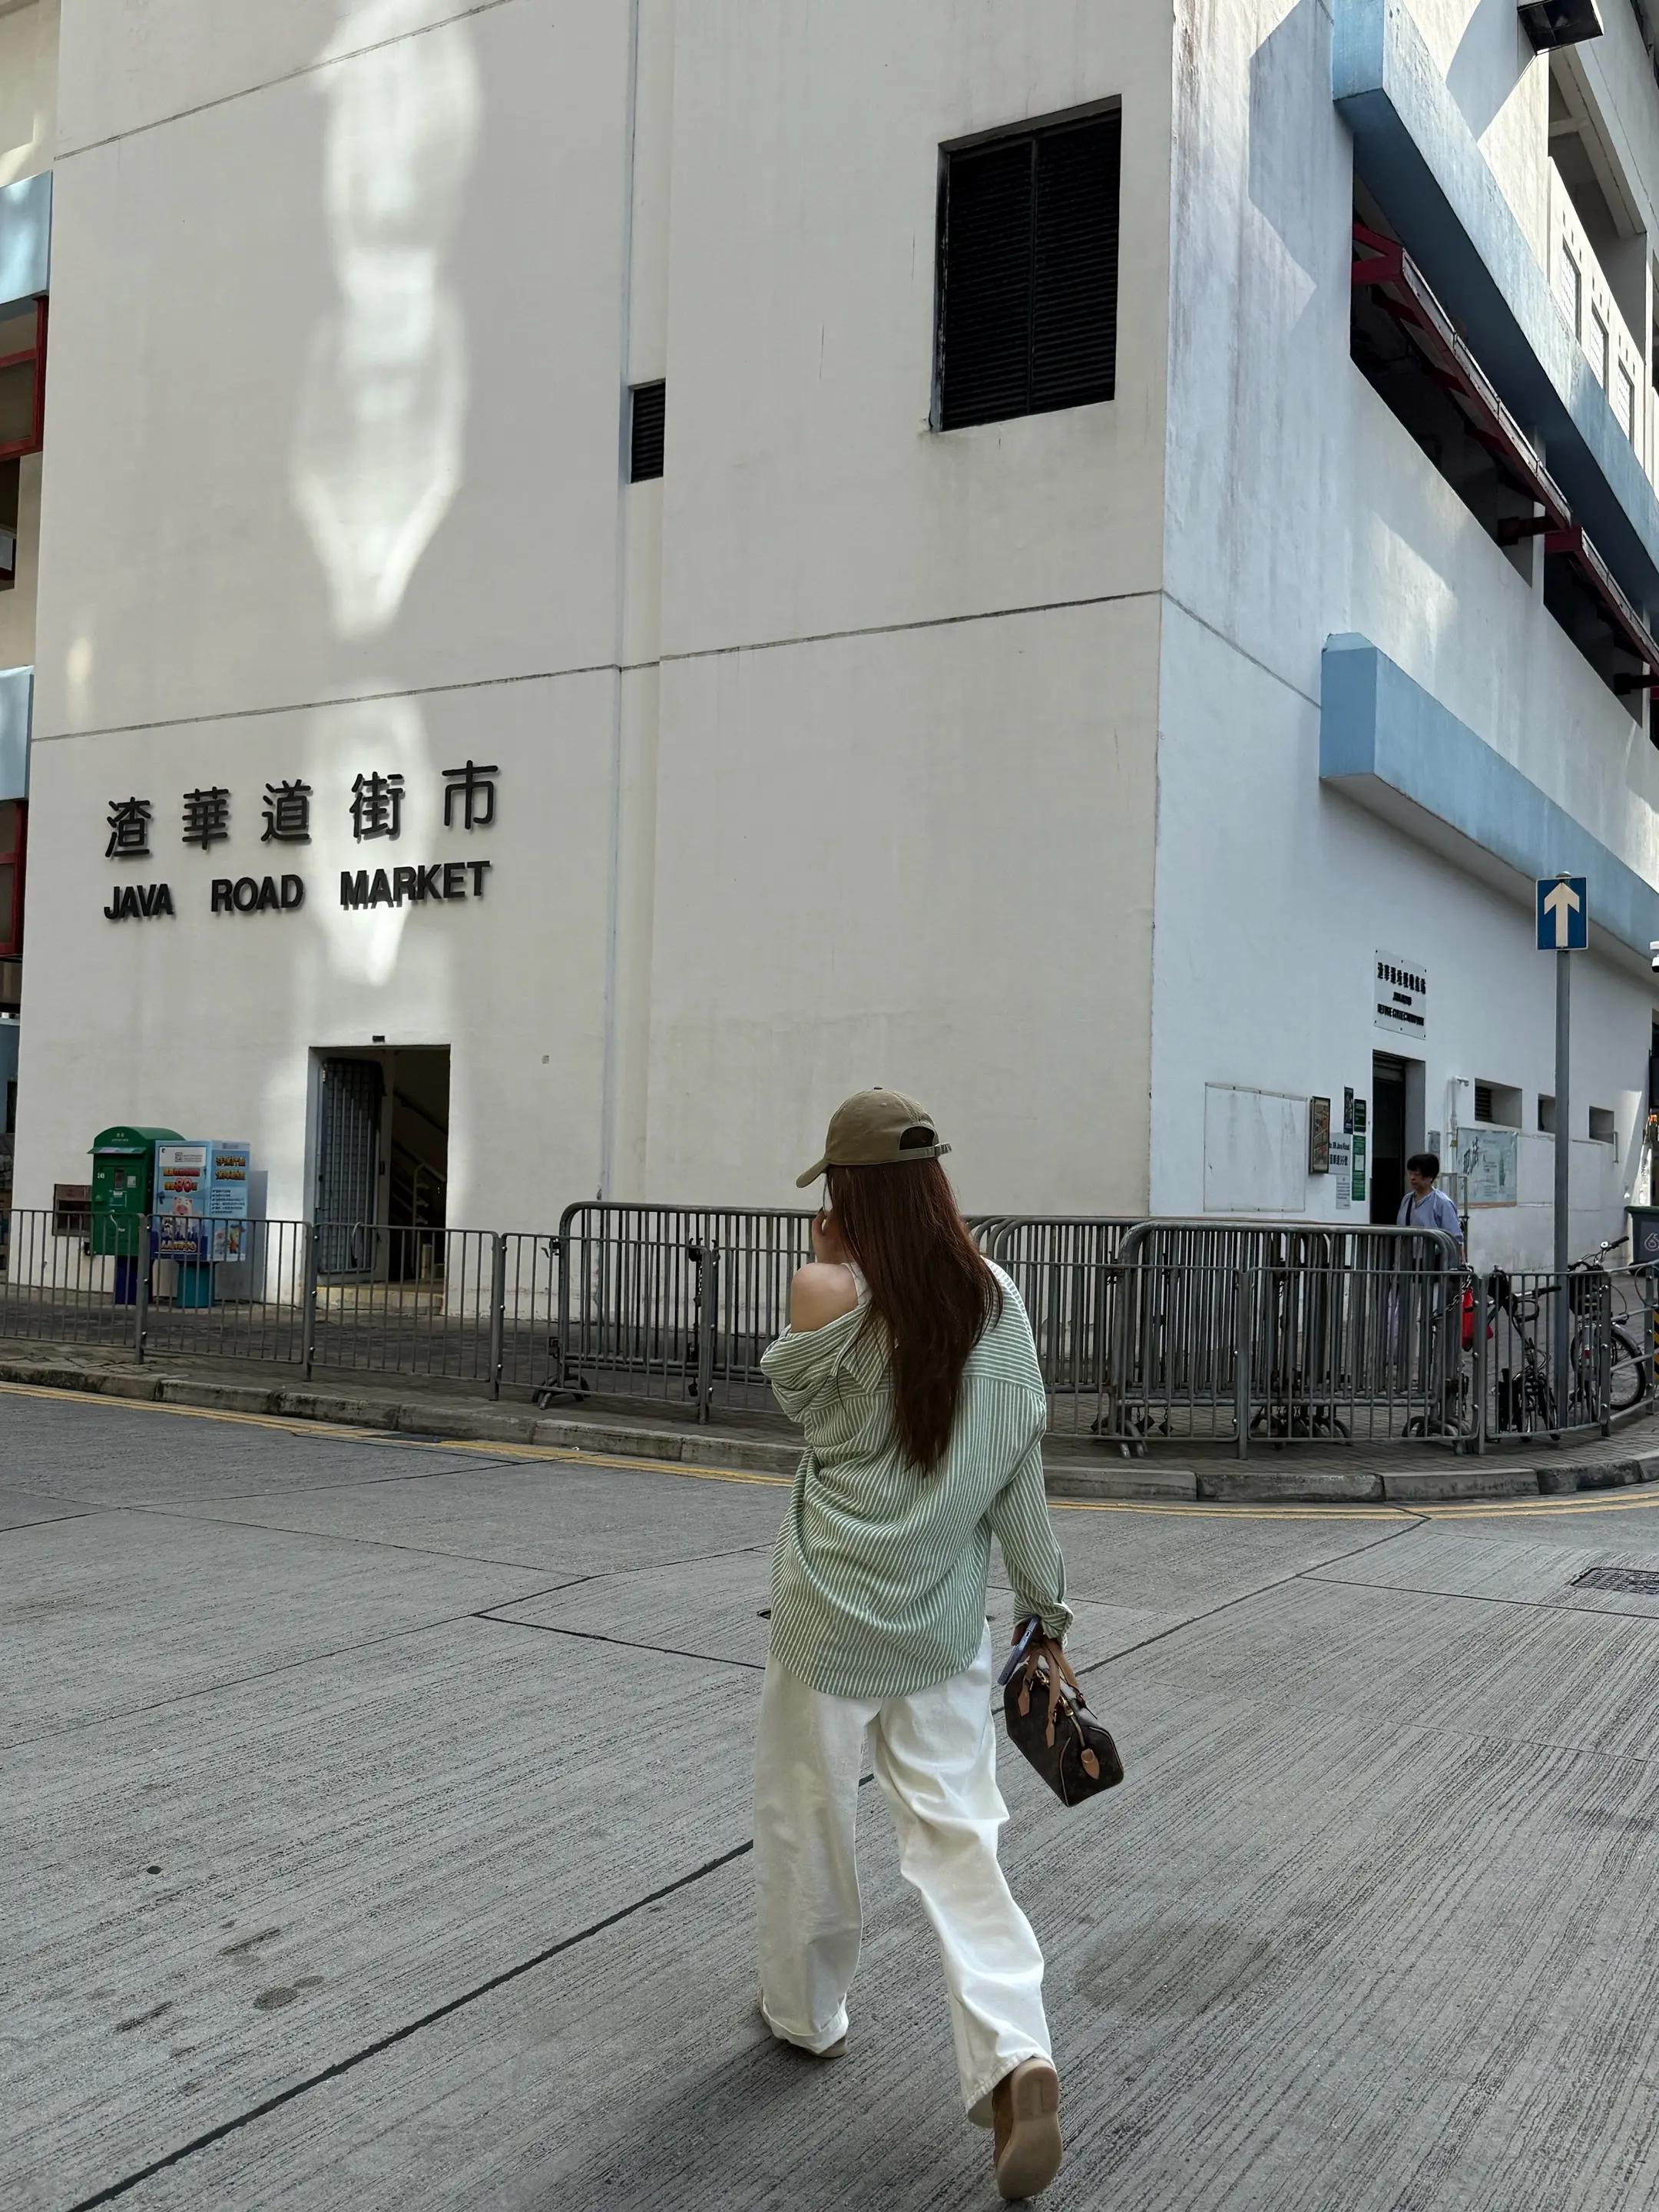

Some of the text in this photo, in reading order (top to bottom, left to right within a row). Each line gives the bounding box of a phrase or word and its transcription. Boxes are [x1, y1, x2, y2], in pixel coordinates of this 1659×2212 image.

[104, 760, 498, 858] 渣華道街市
[104, 860, 490, 919] JAVA ROAD MARKET
